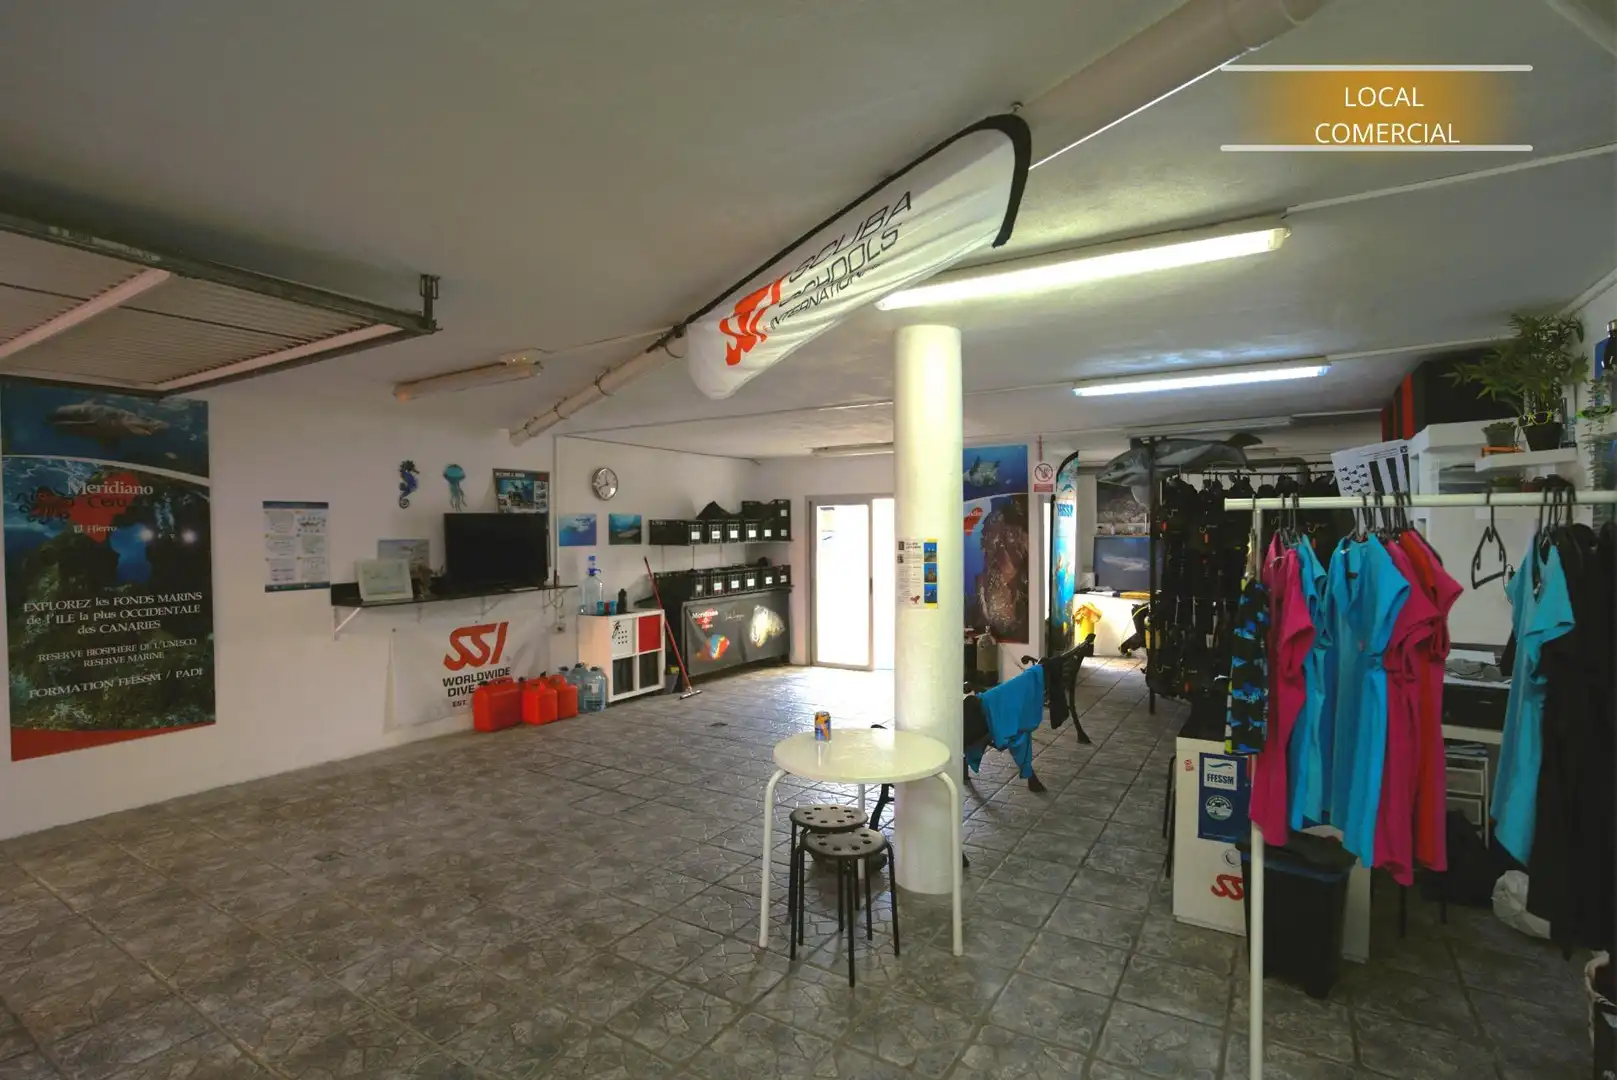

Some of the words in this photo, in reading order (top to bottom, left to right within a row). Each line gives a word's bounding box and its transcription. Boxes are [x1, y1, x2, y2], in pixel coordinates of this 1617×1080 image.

[788, 191, 912, 283] SCUBA
[67, 476, 154, 496] Meridiano
[86, 524, 118, 534] Hierro
[23, 599, 92, 612] EXPLOREZ
[95, 597, 110, 606] les
[113, 595, 155, 606] FONDS
[157, 592, 203, 603] MARINS
[26, 614, 42, 625] de
[79, 611, 89, 621] la
[93, 610, 117, 622] plus
[119, 604, 201, 619] OCCIDENTALE
[77, 624, 97, 635] des
[99, 620, 161, 634] CANARIES
[38, 649, 84, 662] RESERVE
[443, 621, 509, 672] SSI
[83, 655, 126, 668] RESERVE
[126, 651, 165, 664] MARINE
[28, 679, 115, 699] FORMATION
[175, 667, 204, 679] PADI
[442, 666, 511, 688] WORLDWIDE
[447, 684, 476, 698] DIVE
[452, 699, 469, 708] EST.
[1206, 772, 1235, 786] FFESSM
[1211, 874, 1244, 901] SS
